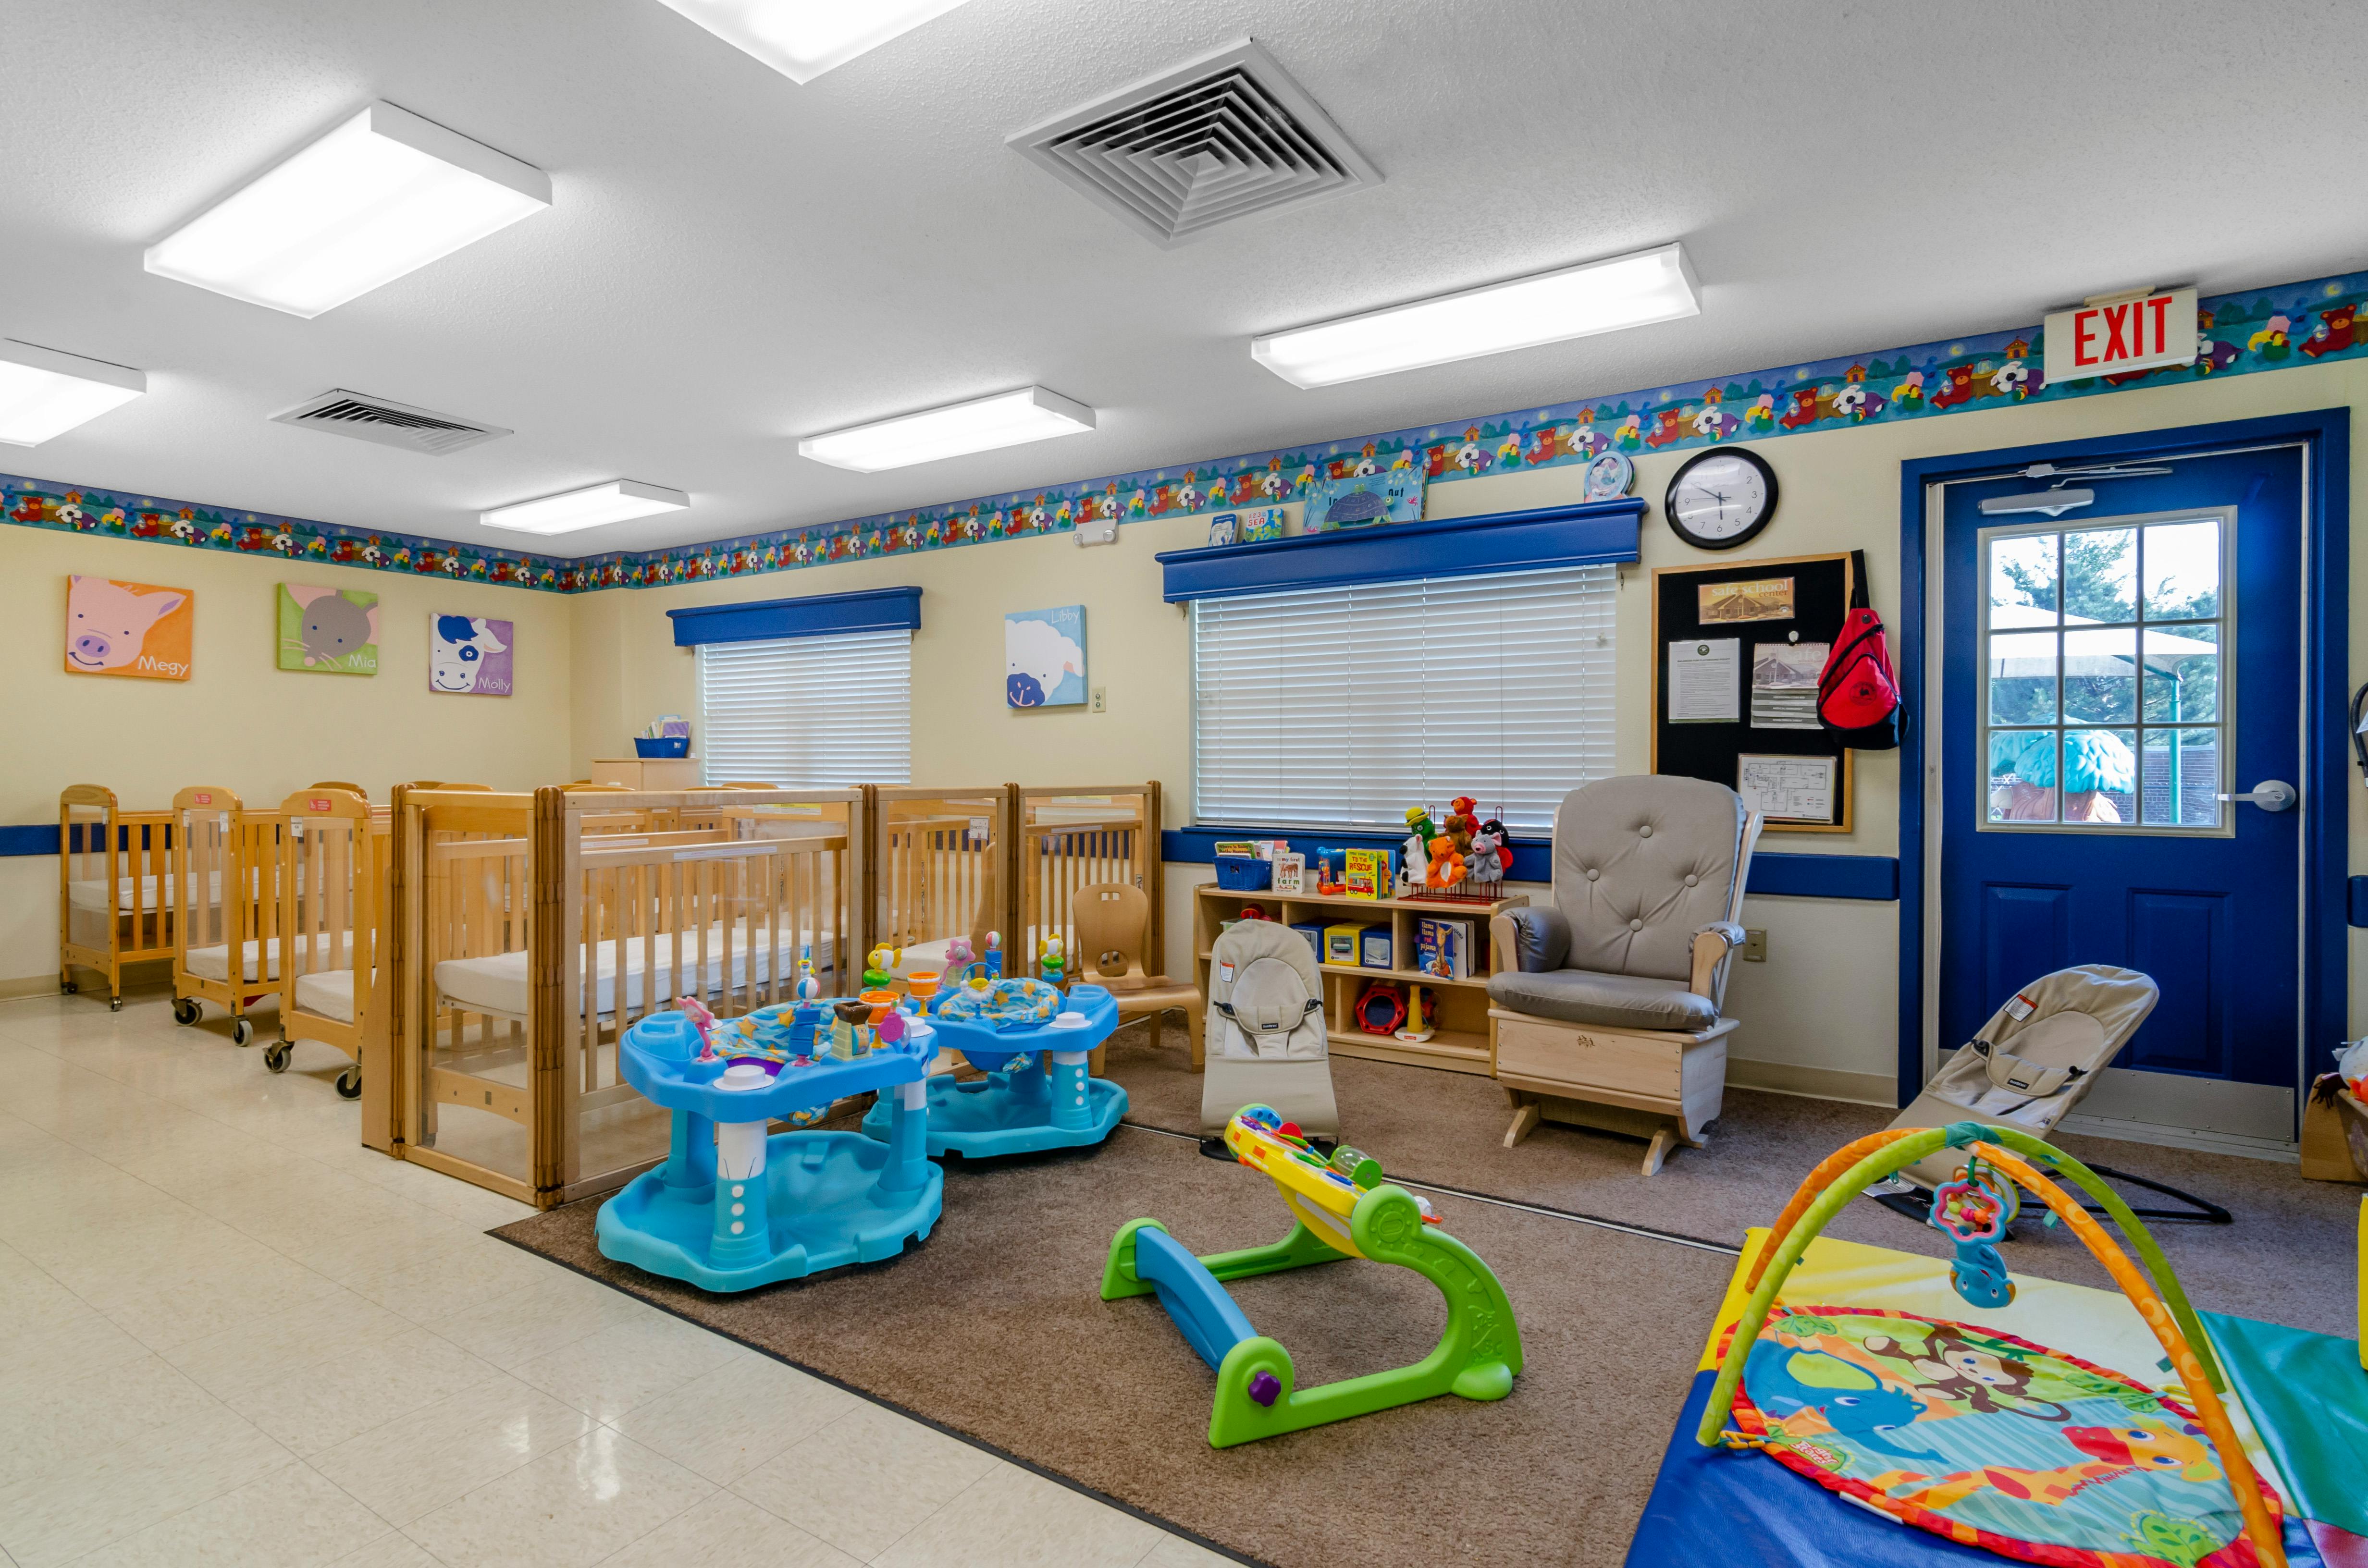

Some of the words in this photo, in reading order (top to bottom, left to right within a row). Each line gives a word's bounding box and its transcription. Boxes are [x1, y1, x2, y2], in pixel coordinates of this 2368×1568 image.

[2074, 296, 2173, 367] EXIT
[1248, 517, 1265, 527] SEA
[1712, 585, 1738, 597] safe
[1742, 580, 1788, 594] school
[1051, 609, 1080, 624] Libby
[1784, 647, 1822, 661] safe
[137, 655, 189, 677] Megy
[347, 654, 377, 669] Mia
[478, 676, 511, 694] Molly
[1349, 863, 1372, 871] RESCUE
[1422, 921, 1434, 930] llama
[1422, 929, 1434, 937] llama
[1420, 943, 1436, 951] pajama
